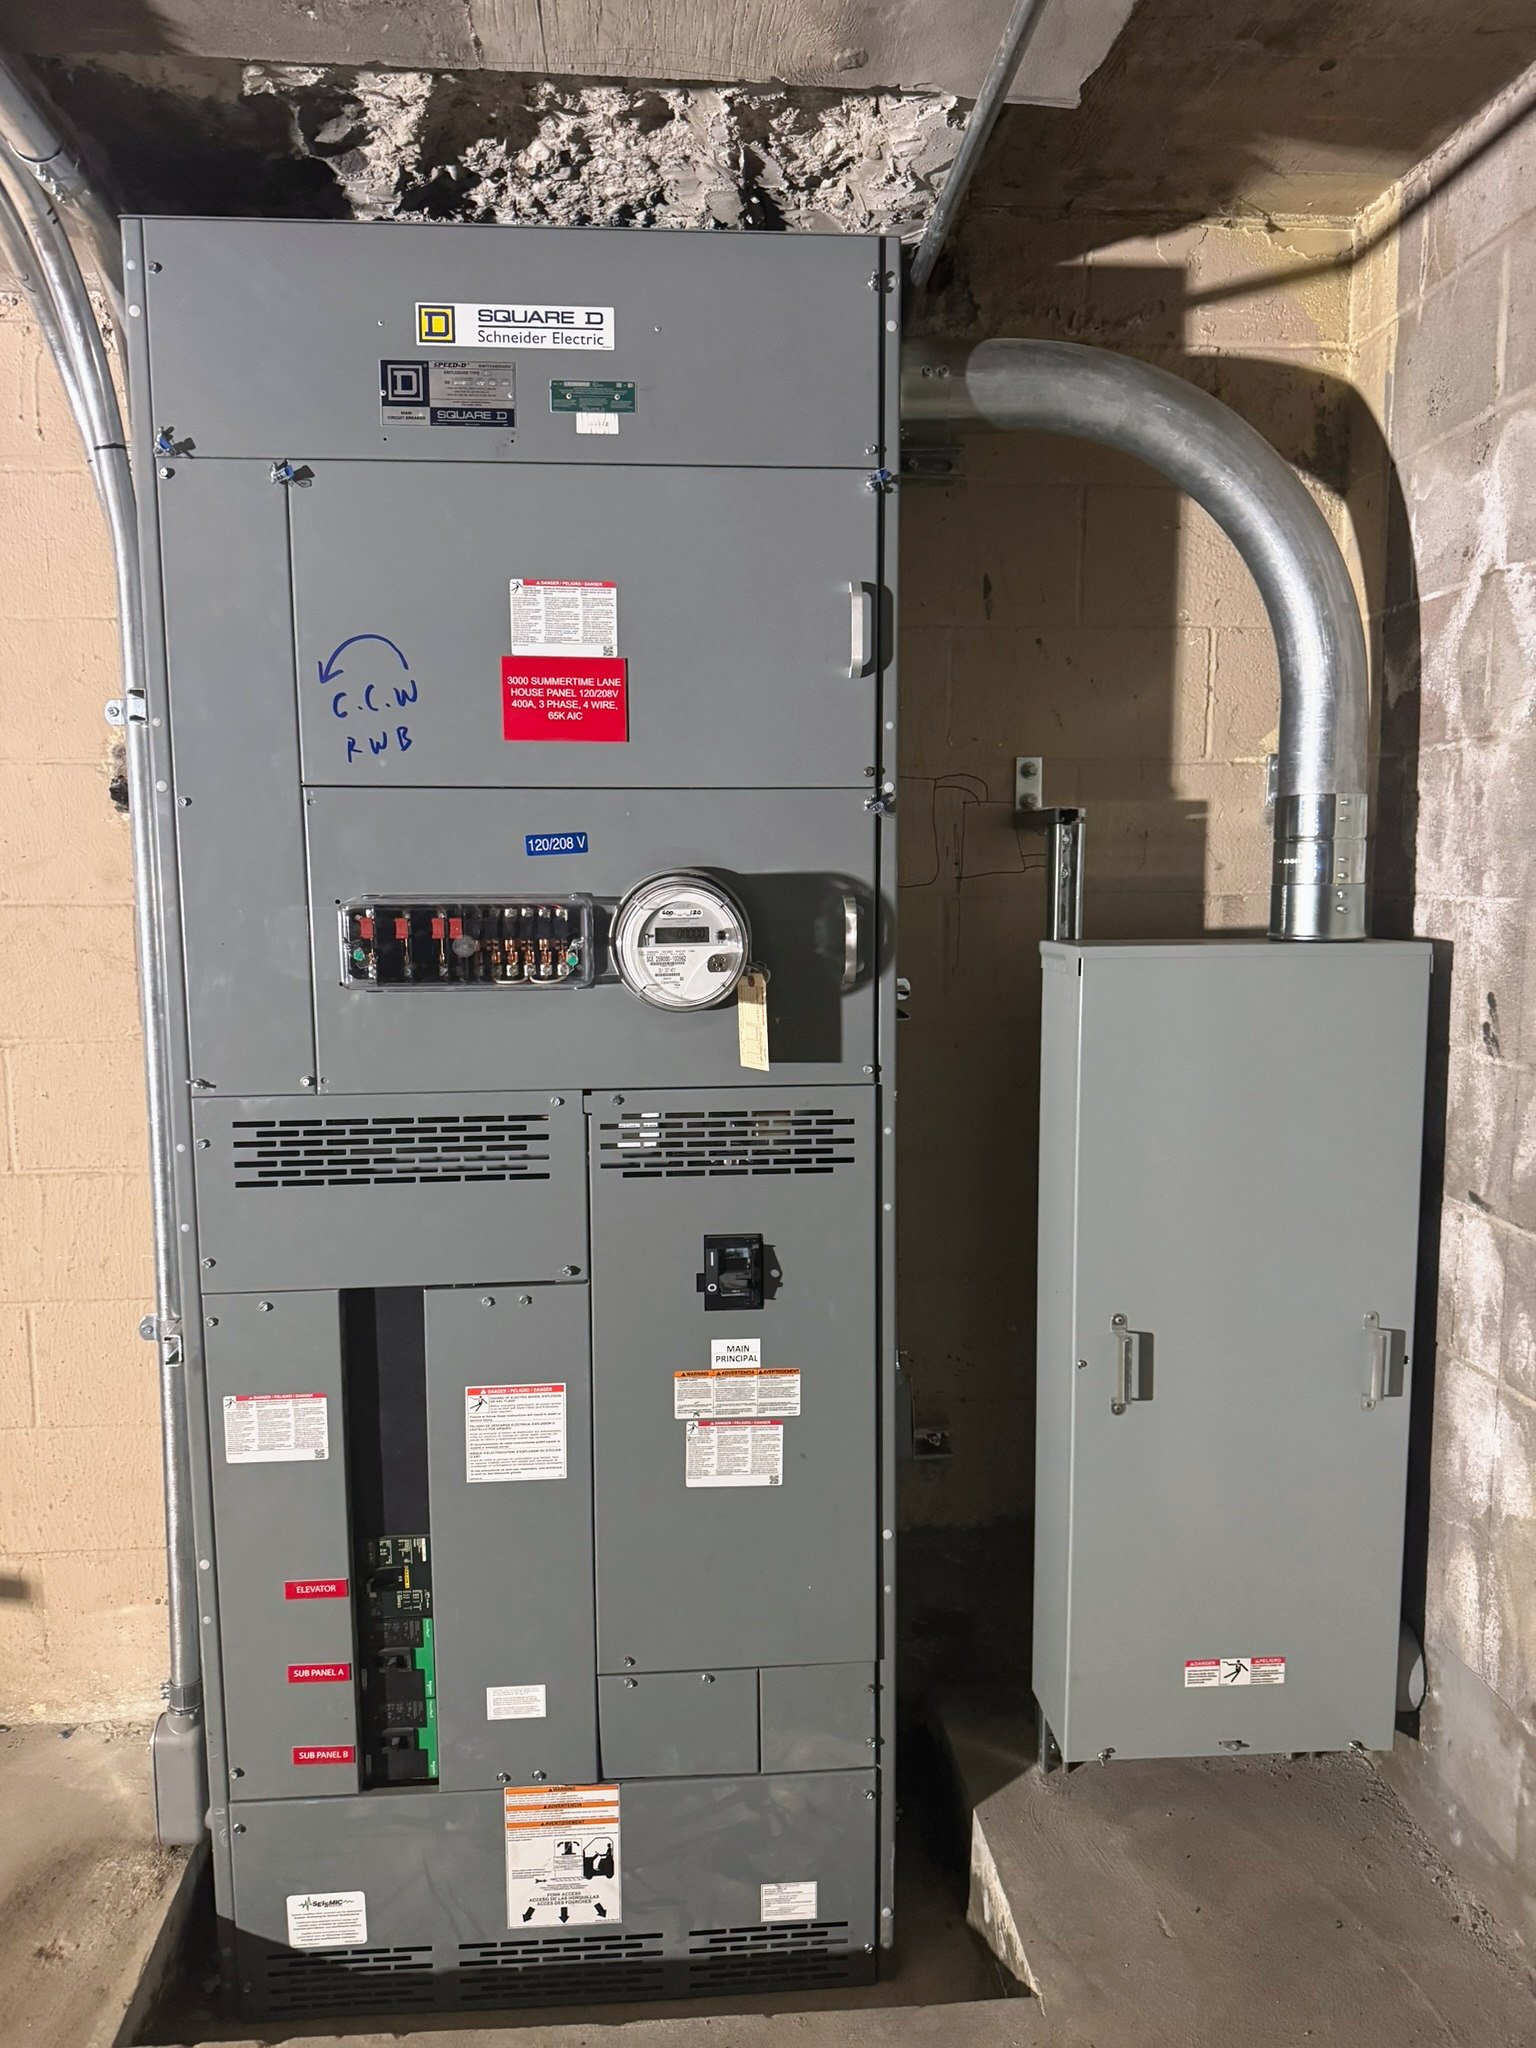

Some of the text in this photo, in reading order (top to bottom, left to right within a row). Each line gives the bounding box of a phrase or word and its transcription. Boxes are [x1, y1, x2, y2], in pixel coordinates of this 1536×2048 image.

[478, 310, 604, 325] SQUARE D
[478, 330, 604, 346] Schneider Electric
[437, 410, 491, 419] SQUARE
[507, 676, 621, 686] 3000 SUMMERTIME LANE
[511, 688, 619, 698] HOUSE PANEL 120/208V
[512, 700, 536, 709] 400A,
[546, 700, 581, 710] PHASE,
[590, 701, 618, 710] WIRE,
[548, 712, 565, 720] 65K
[528, 836, 585, 851] 120/208 V
[296, 1585, 336, 1593] ELEVATOR
